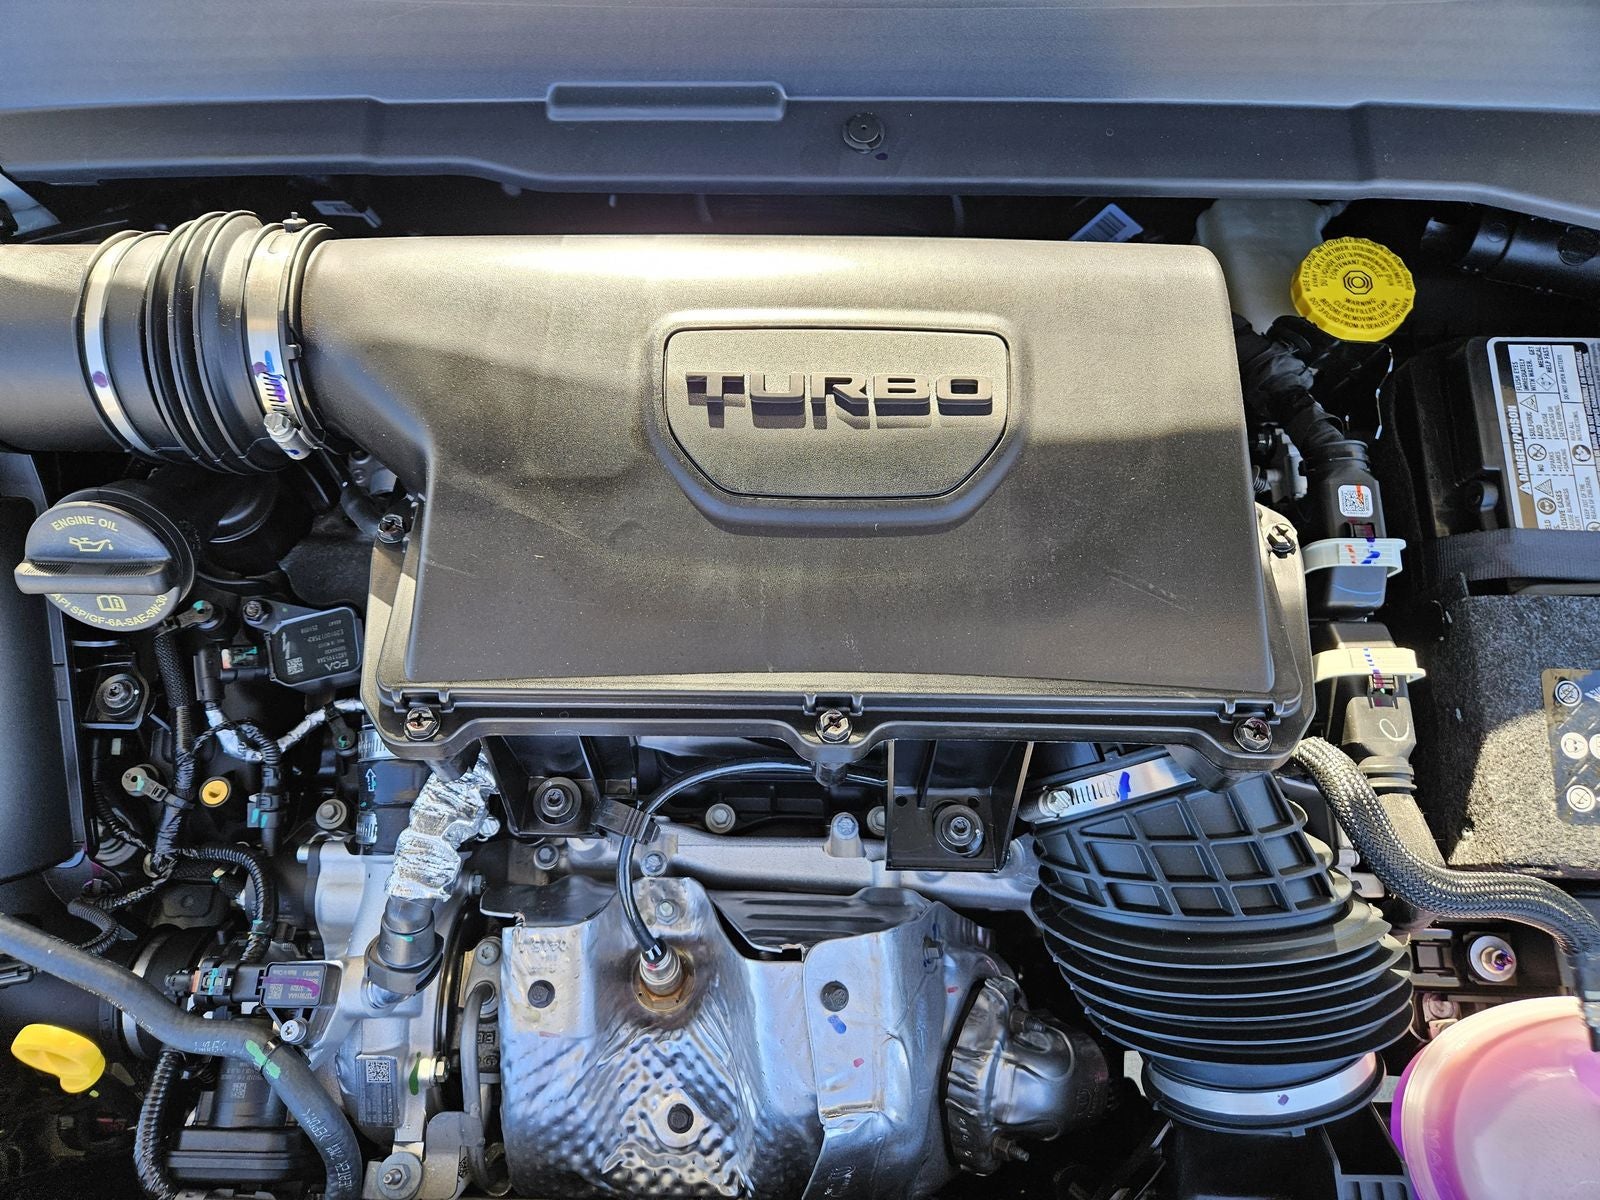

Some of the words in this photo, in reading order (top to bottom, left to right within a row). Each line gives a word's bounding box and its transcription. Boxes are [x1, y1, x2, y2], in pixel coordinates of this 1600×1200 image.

[1340, 319, 1360, 328] FROM
[1536, 346, 1544, 368] MEDICAL
[1514, 375, 1522, 391] FLUSH
[1519, 359, 1529, 391] IMMEDIATELY
[686, 371, 993, 416] TURBO
[1526, 412, 1536, 436] SULFURIC
[1536, 425, 1544, 436] ACID
[1508, 405, 1529, 481] DANGER/POISON
[1537, 464, 1544, 472] NO
[1555, 490, 1564, 508] GASES
[51, 515, 96, 531] ENGINE
[98, 518, 119, 532] OIL
[51, 593, 72, 608] API
[325, 659, 349, 670] FCA
